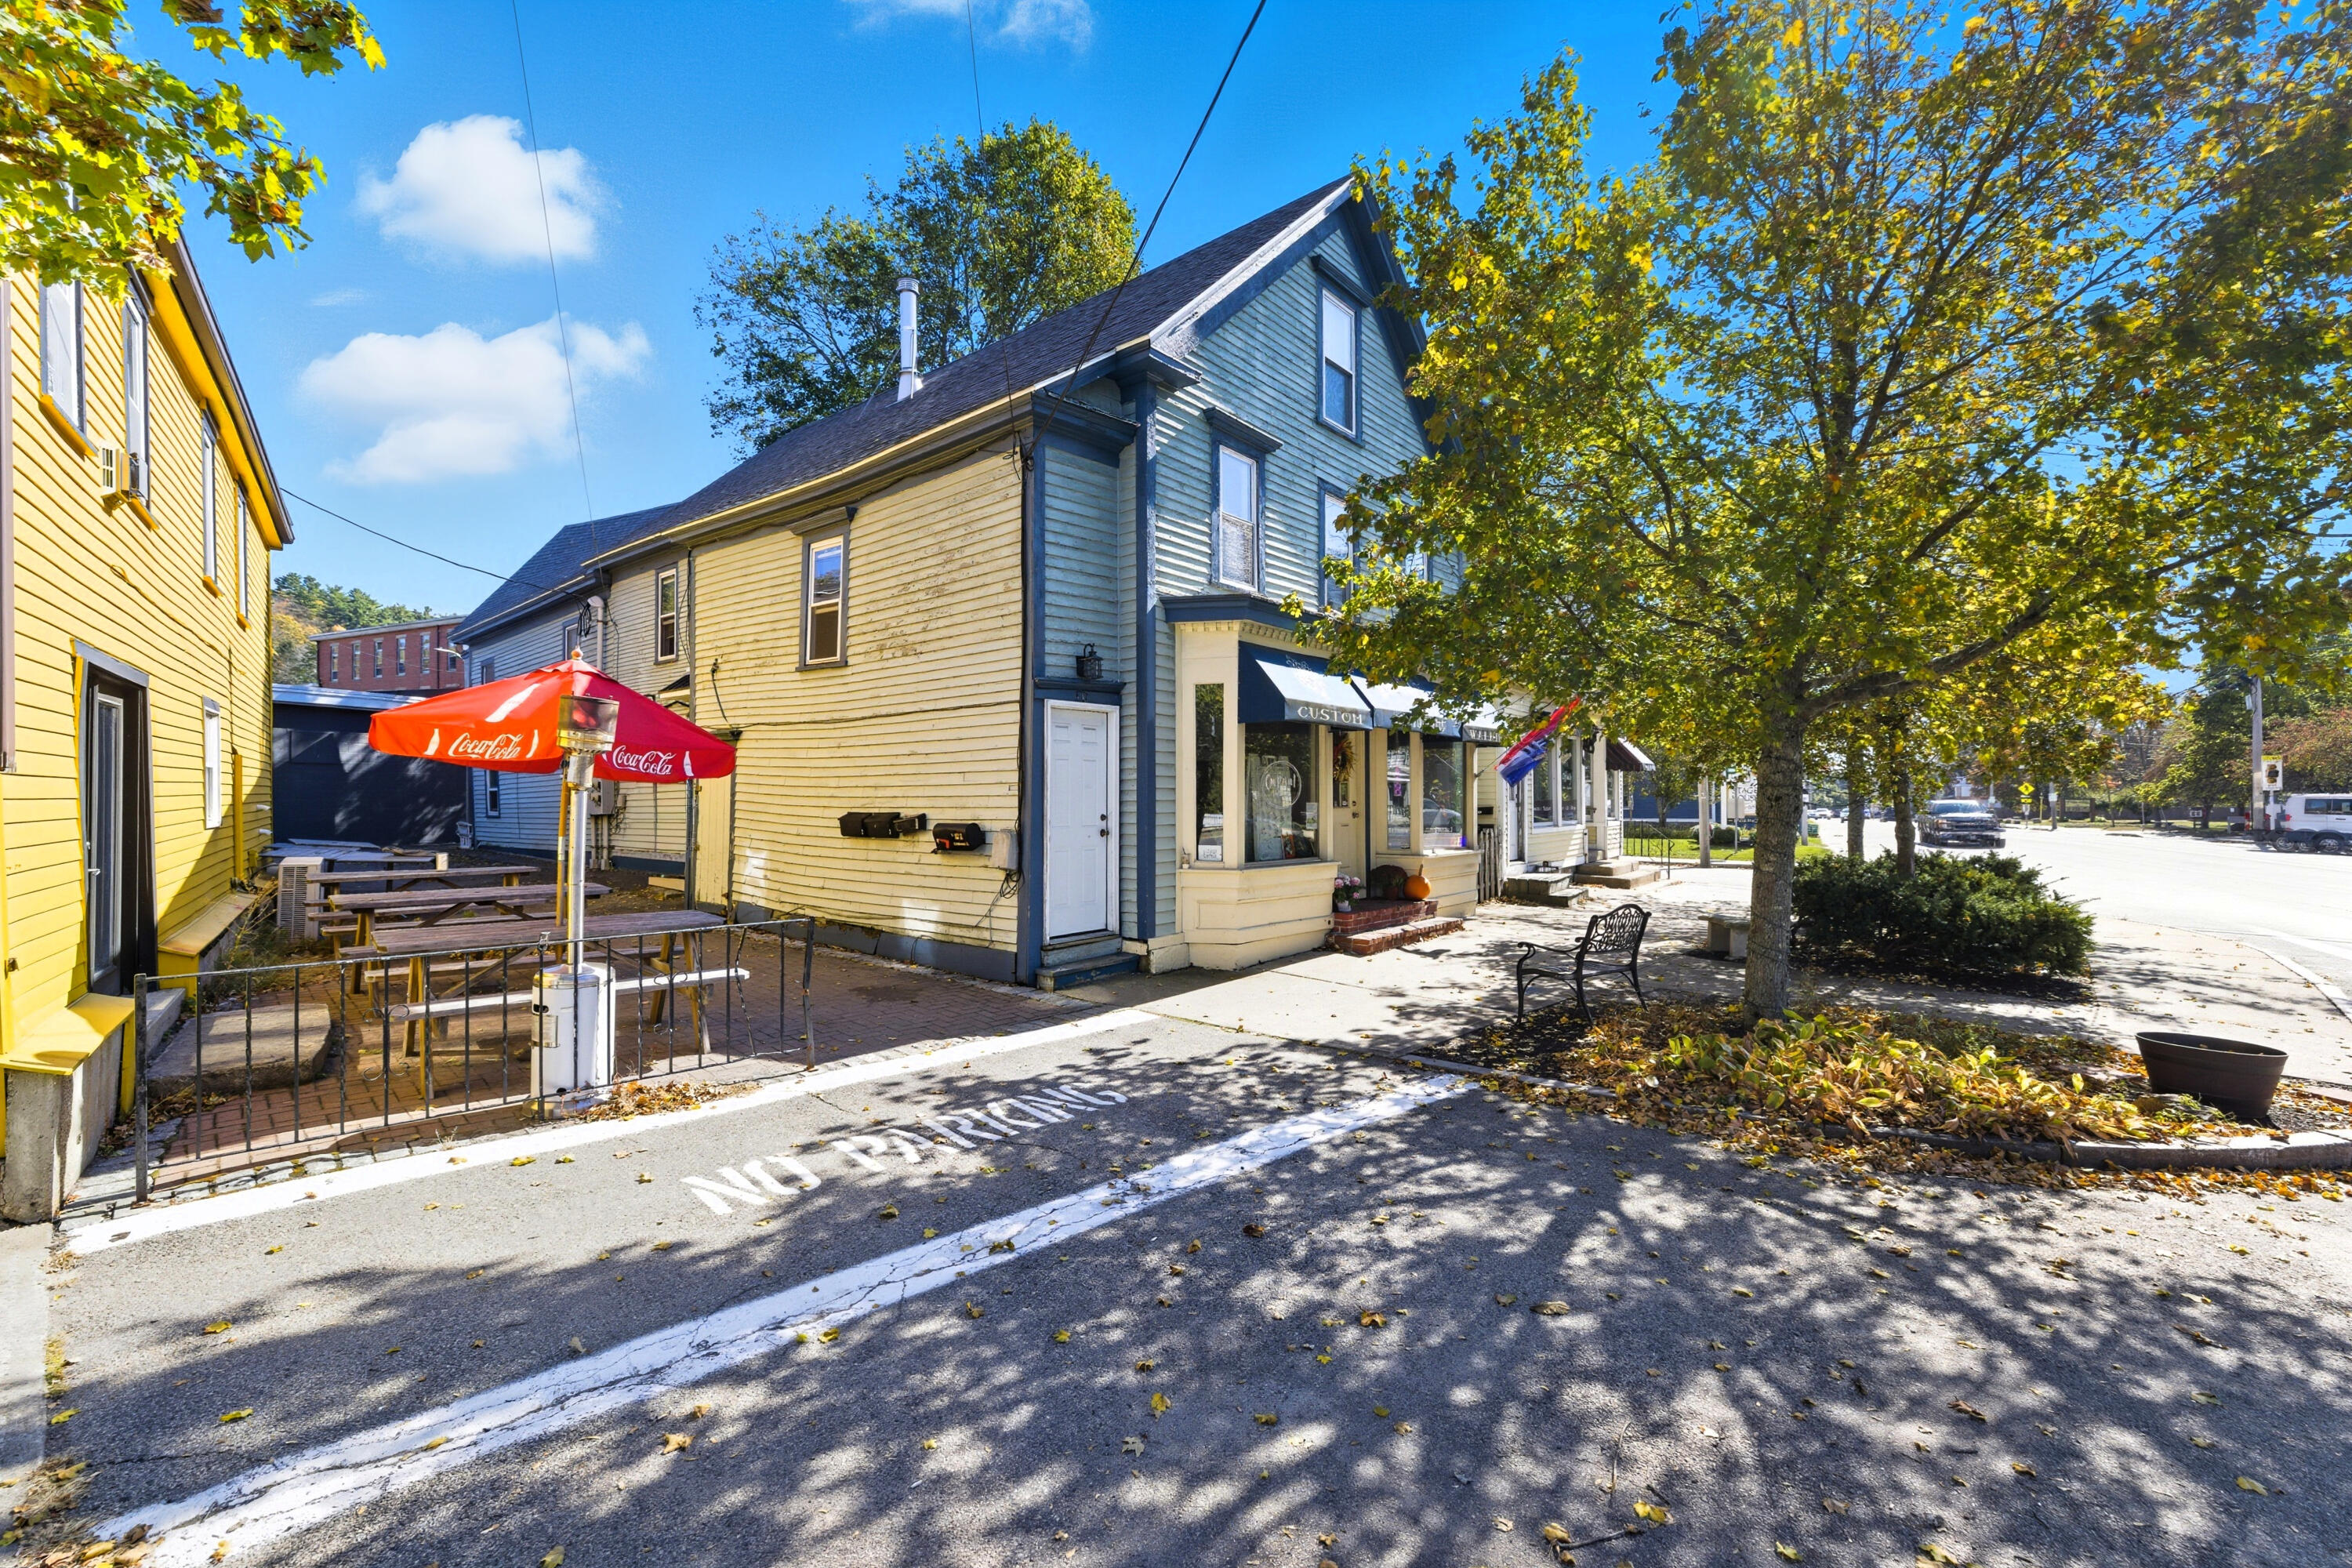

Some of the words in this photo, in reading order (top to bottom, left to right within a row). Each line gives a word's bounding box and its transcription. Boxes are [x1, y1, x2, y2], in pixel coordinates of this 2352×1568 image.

[1297, 706, 1363, 724] CUSTOM
[448, 732, 524, 760] Coca-Cola
[612, 745, 677, 775] Coca-Cola
[681, 1156, 822, 1215] NO
[831, 1084, 1128, 1172] PARKING
